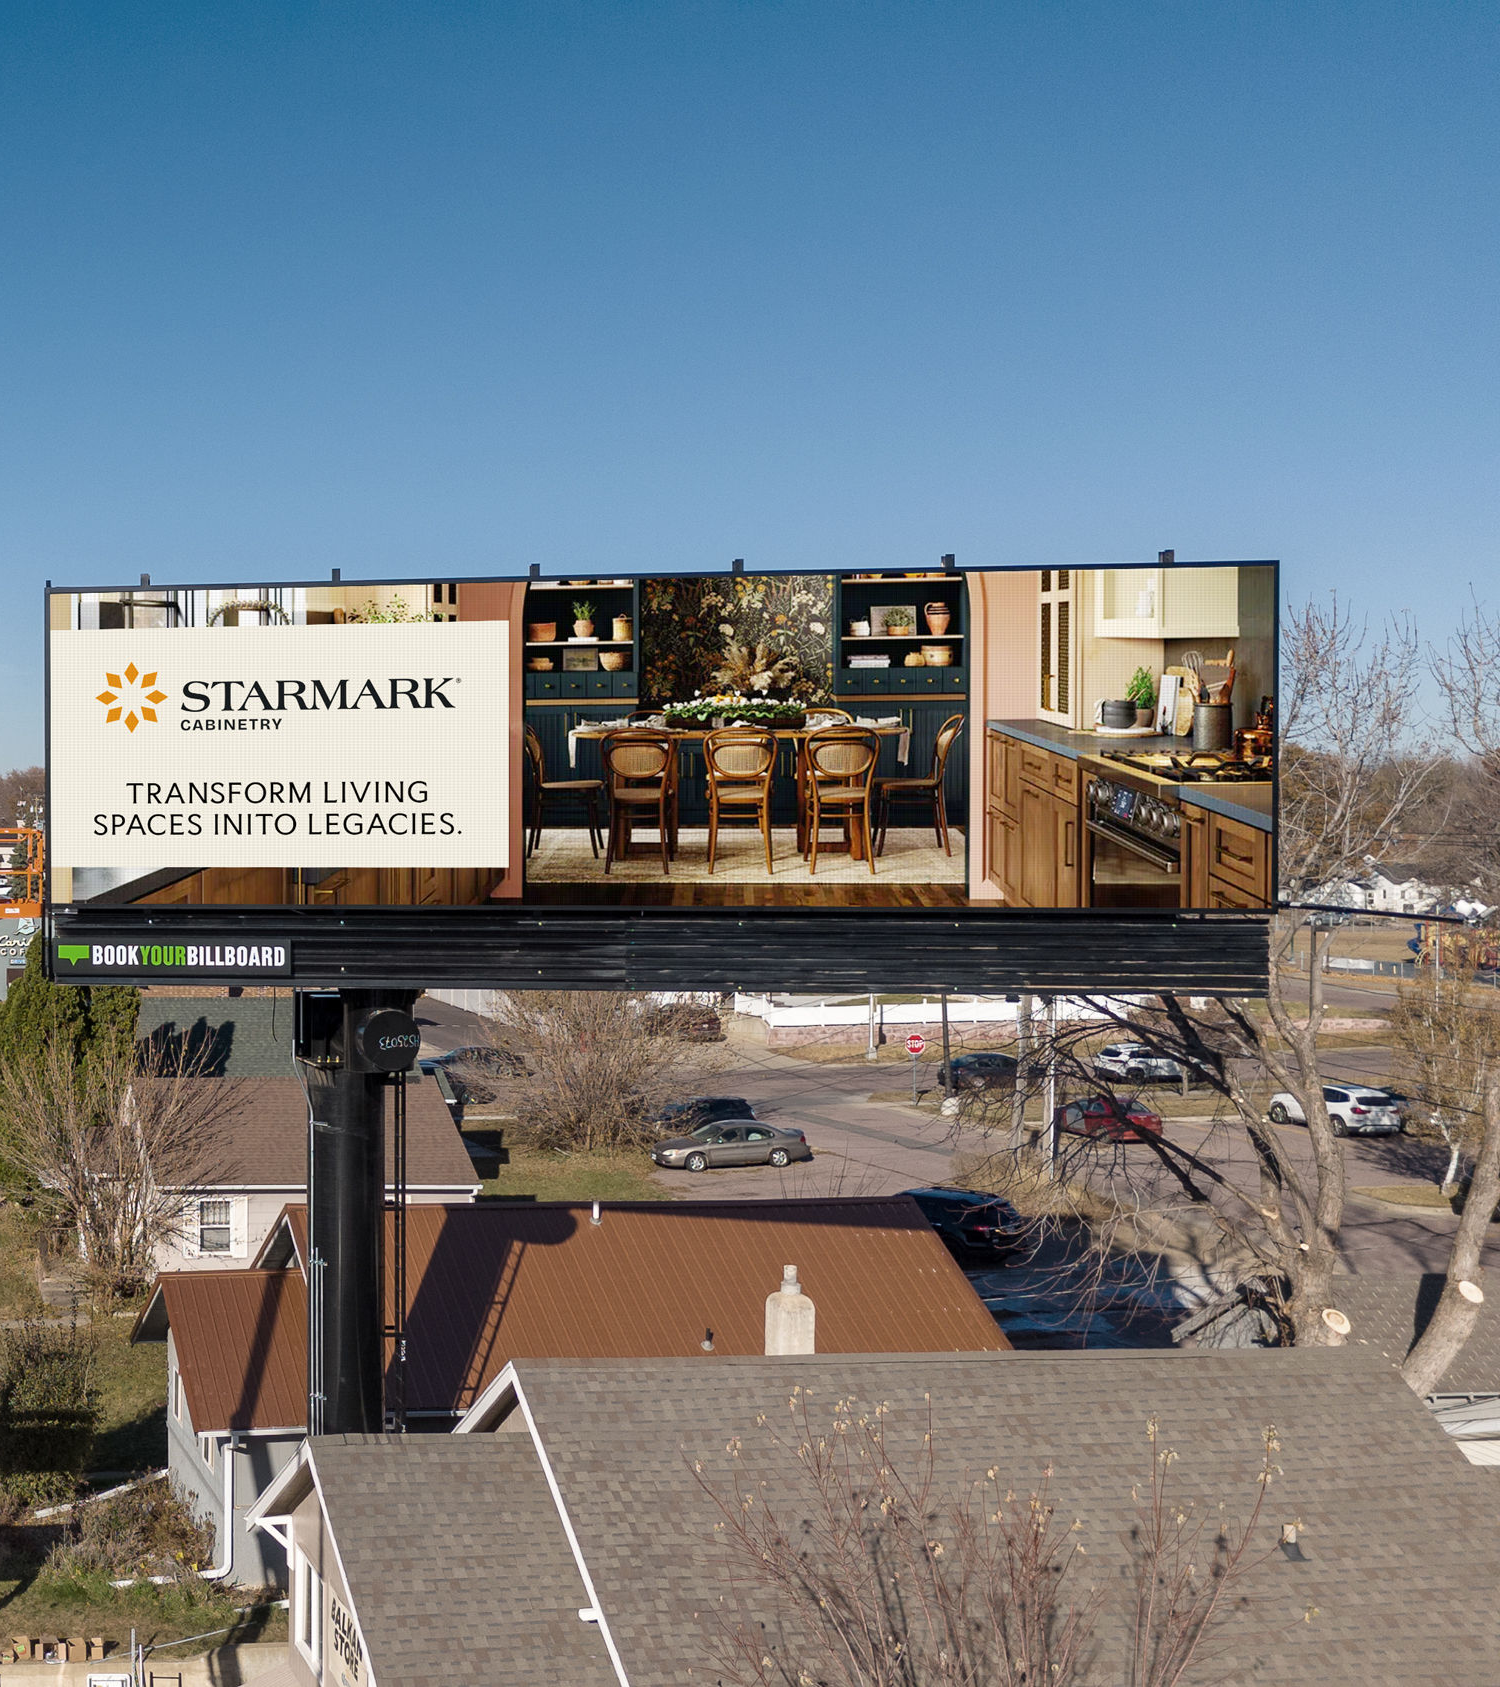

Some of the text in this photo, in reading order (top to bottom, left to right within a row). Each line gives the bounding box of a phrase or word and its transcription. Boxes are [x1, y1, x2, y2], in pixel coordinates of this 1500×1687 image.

[180, 718, 282, 732] CABINETRY
[126, 781, 428, 804] TRANSFORM LIVING
[94, 813, 462, 835] SPACES INITO LEGACIES.
[907, 1039, 924, 1048] STOP
[331, 1597, 362, 1662] BALKAN
[334, 1628, 358, 1682] STORE
